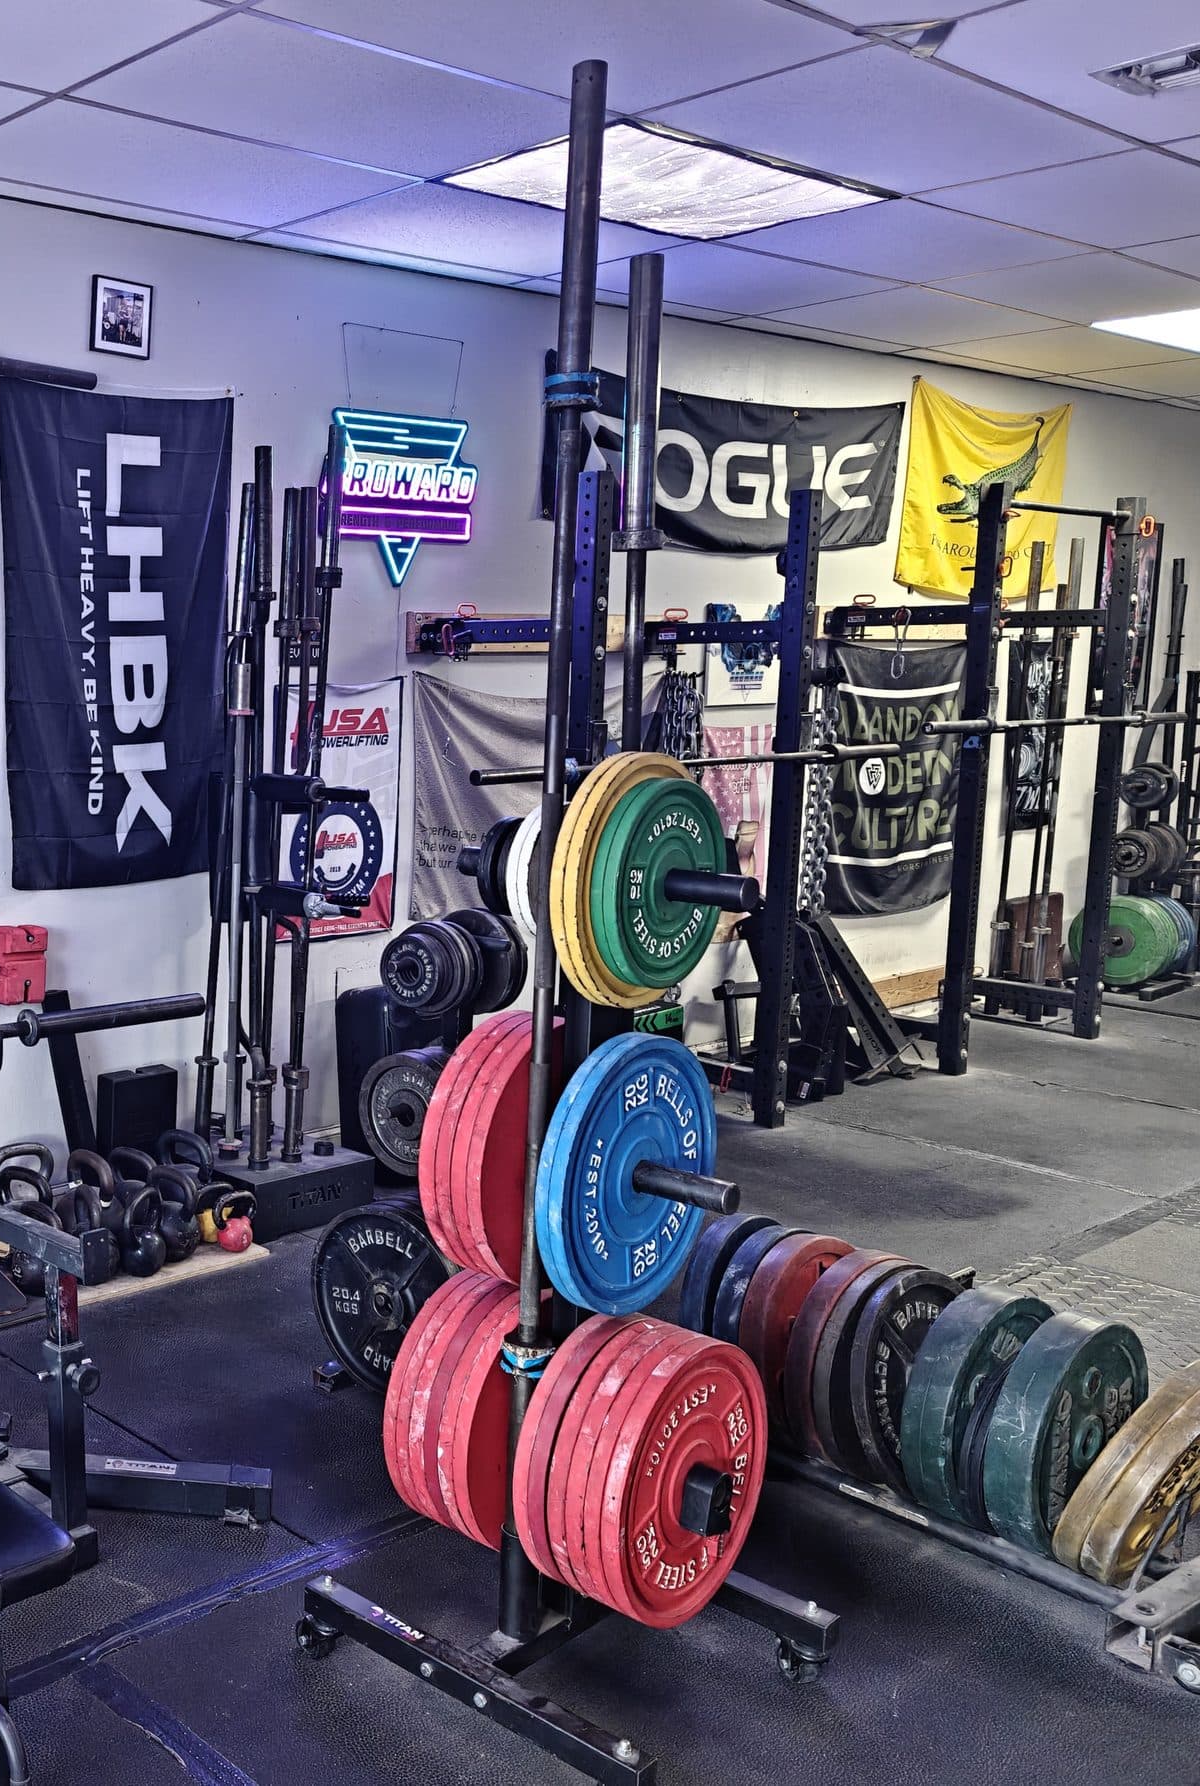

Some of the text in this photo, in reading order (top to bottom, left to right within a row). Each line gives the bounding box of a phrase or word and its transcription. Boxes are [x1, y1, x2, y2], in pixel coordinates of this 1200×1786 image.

[344, 460, 477, 503] ROWARD
[76, 468, 93, 540] LIFT
[105, 433, 172, 853] LHBK
[83, 679, 98, 723] BE
[320, 734, 389, 748] OWERLIFTING
[87, 729, 104, 815] KIND
[631, 907, 704, 958] BELLS OF STEEL
[624, 1084, 637, 1112] 20
[634, 1072, 649, 1107] KG
[655, 1073, 698, 1242] BELLS OF EEL
[347, 1228, 415, 1260] BARBELL
[643, 1239, 657, 1267] 20
[633, 1246, 646, 1277] KG
[332, 1286, 361, 1302] 20.4
[335, 1300, 359, 1316] KGS
[727, 1402, 744, 1431] 25
[728, 1417, 748, 1447] KG
[636, 1521, 656, 1550] KG
[641, 1539, 659, 1570] 25
[655, 1558, 697, 1590] STEEL
[384, 1613, 425, 1640] TITAN
